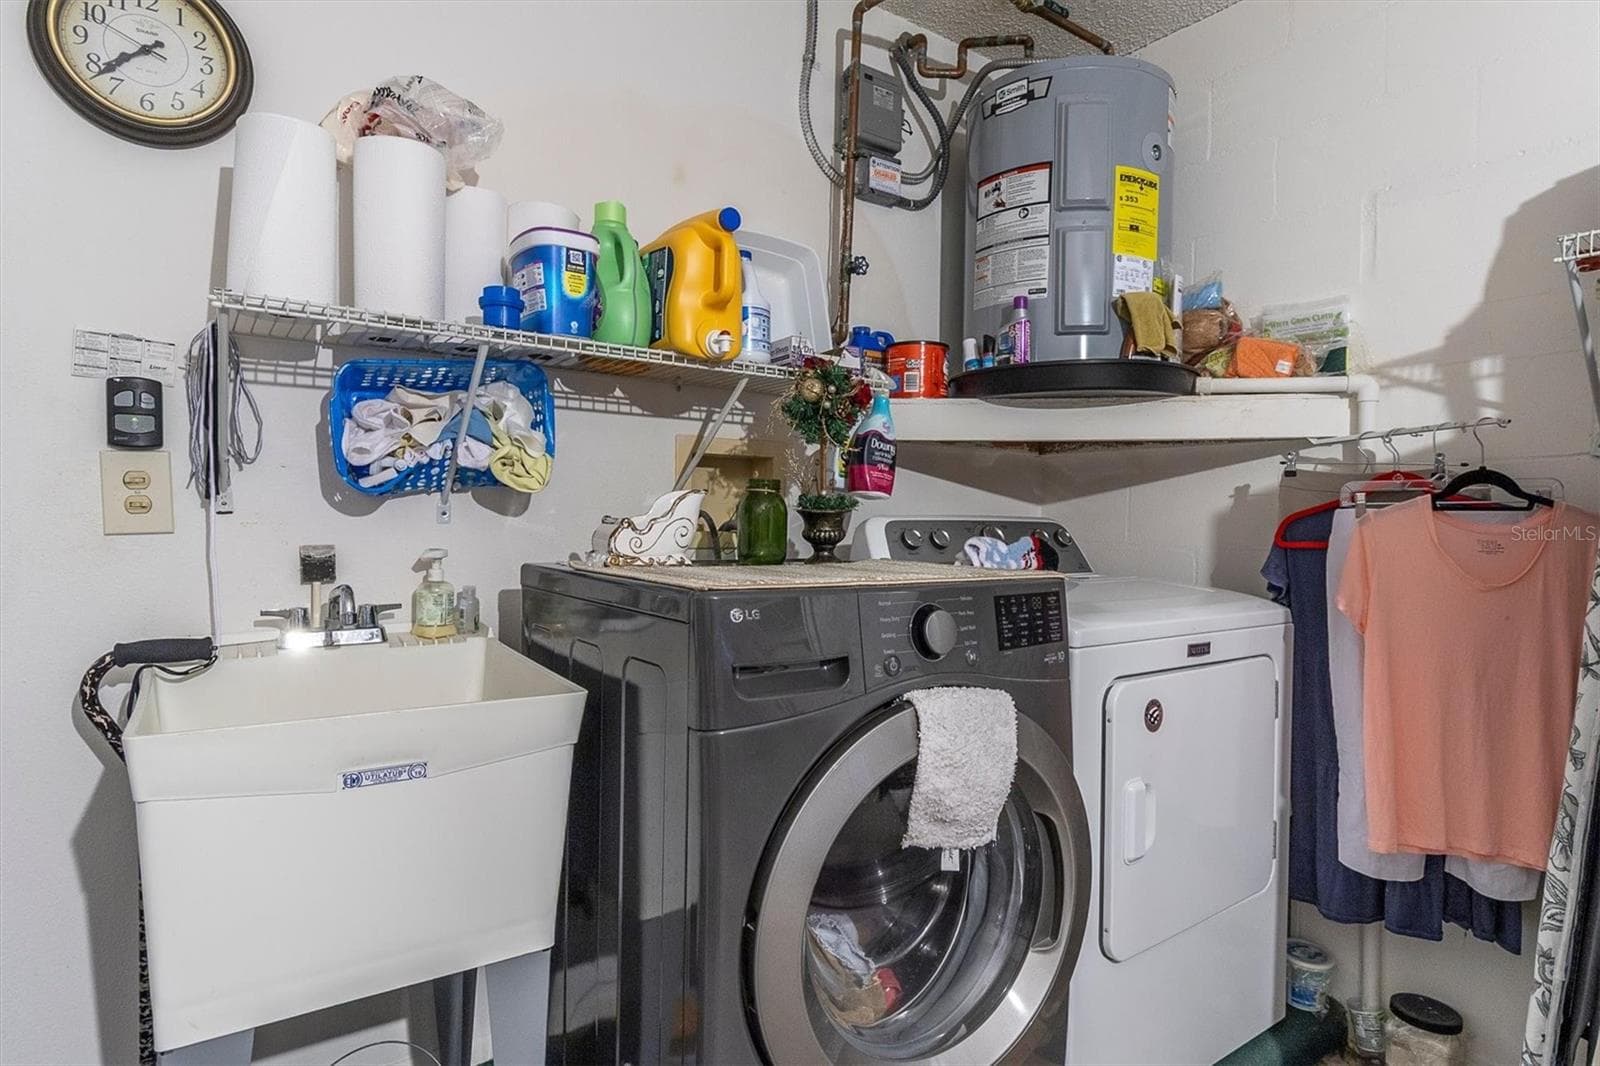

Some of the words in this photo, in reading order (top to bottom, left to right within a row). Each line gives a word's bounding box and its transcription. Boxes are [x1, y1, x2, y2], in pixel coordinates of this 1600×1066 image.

[82, 1, 106, 25] 10
[176, 7, 184, 27] 1
[72, 25, 88, 45] 9
[193, 31, 207, 51] 2
[86, 52, 102, 74] 8
[200, 56, 214, 76] 3
[108, 77, 124, 96] 7
[190, 80, 206, 99] 4
[140, 93, 155, 112] 6
[171, 92, 185, 111] 5
[871, 438, 896, 456] Downy
[745, 609, 761, 620] LG
